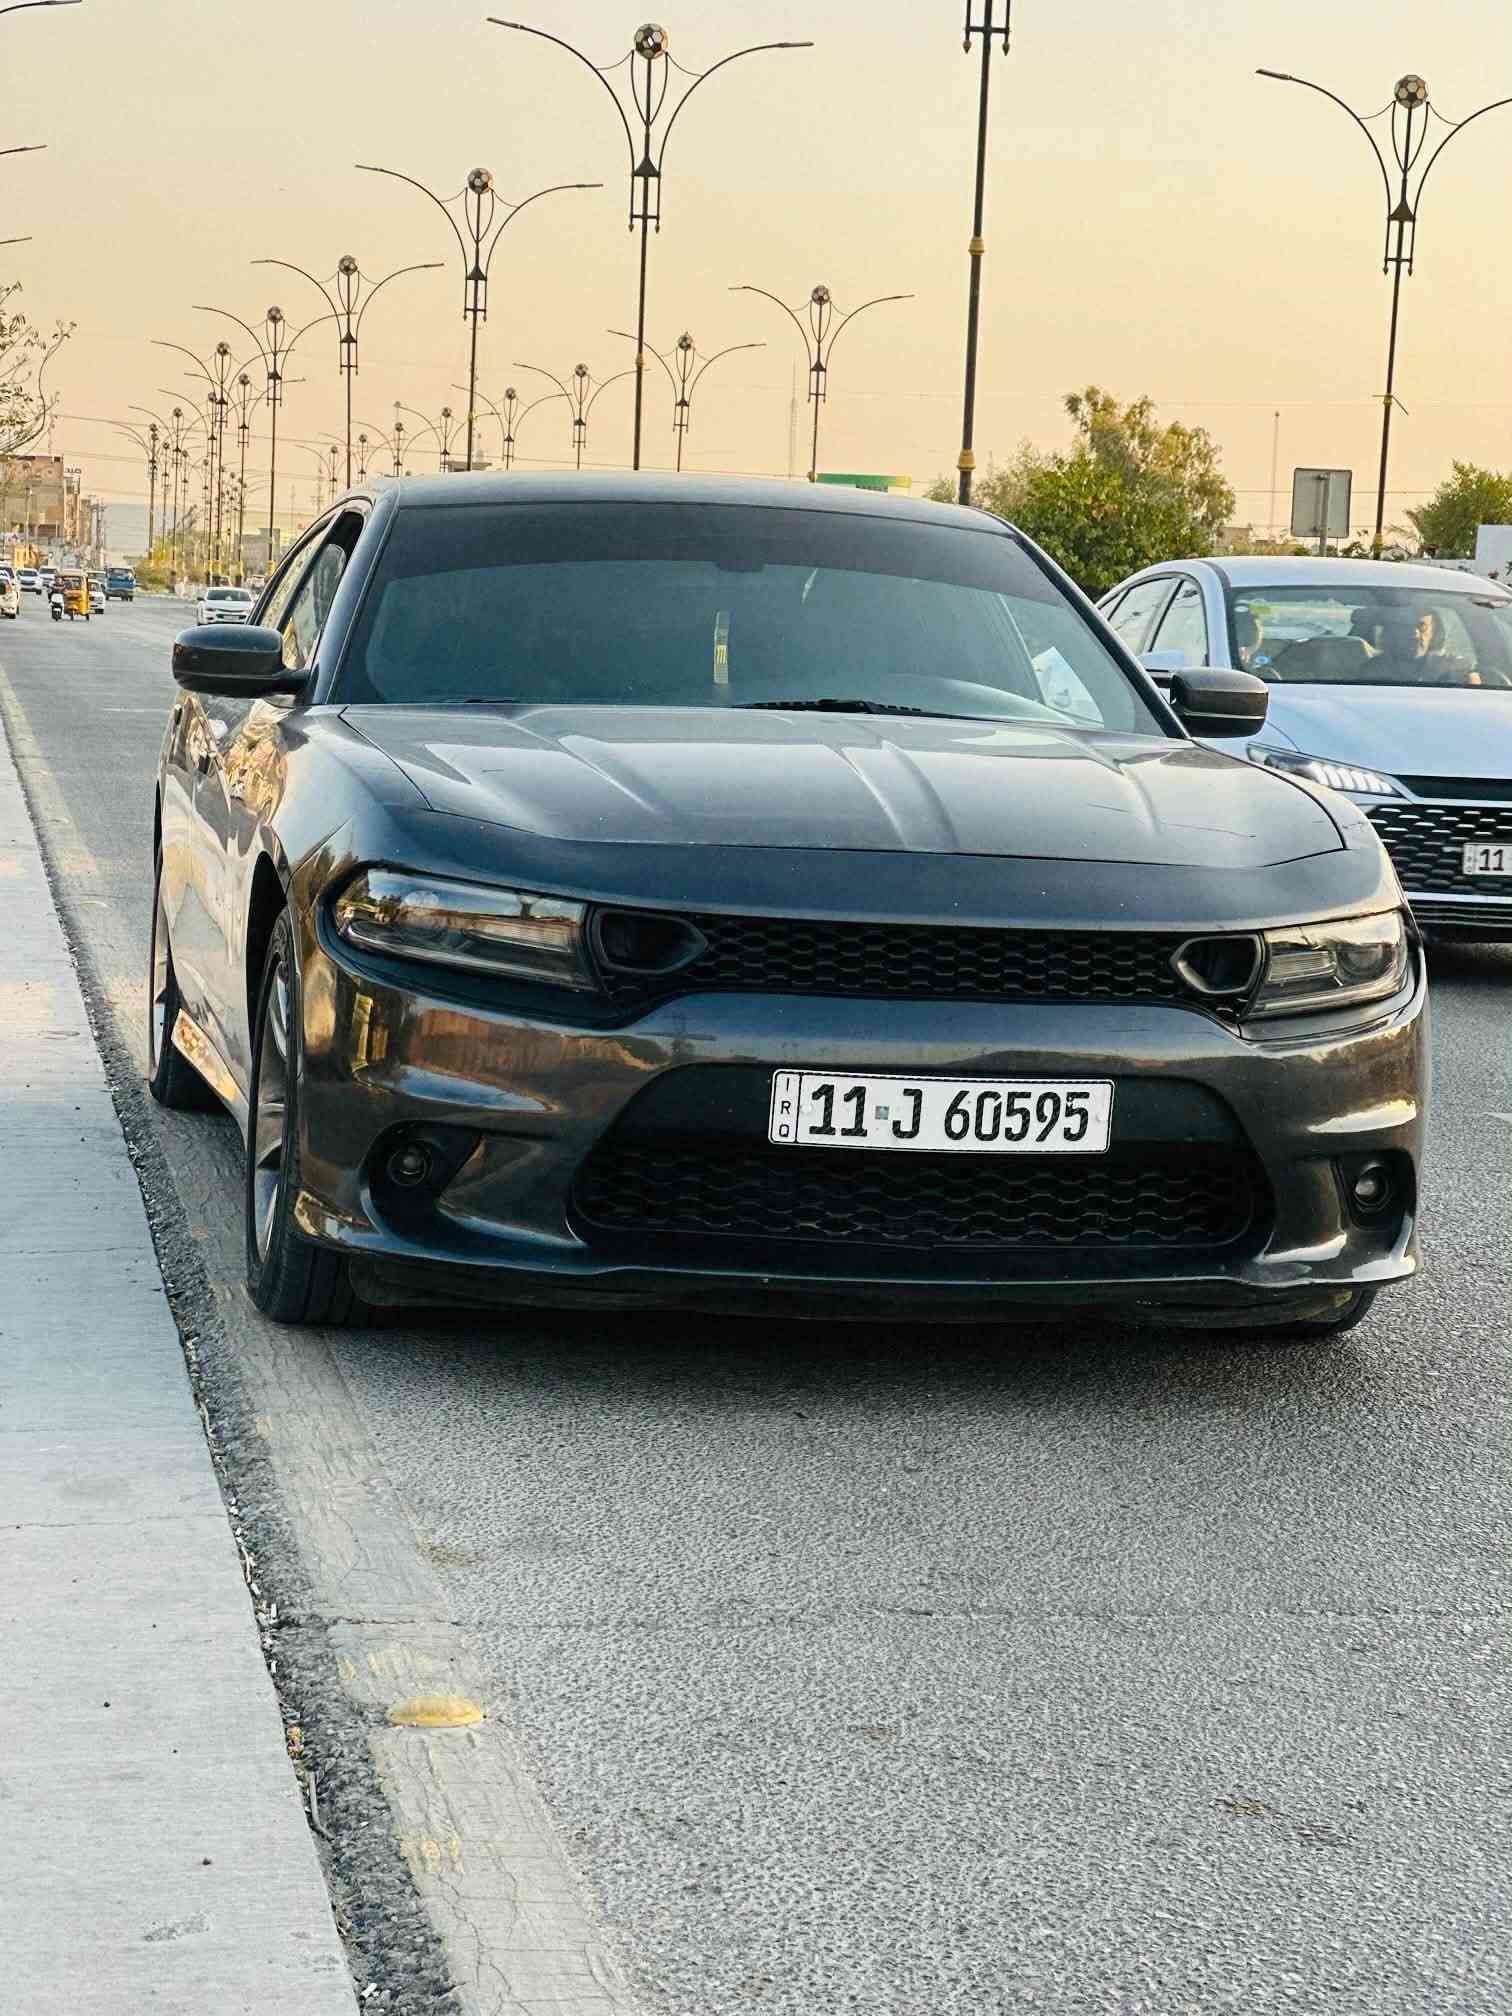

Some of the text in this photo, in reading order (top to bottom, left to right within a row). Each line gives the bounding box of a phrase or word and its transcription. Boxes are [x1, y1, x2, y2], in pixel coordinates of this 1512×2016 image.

[1479, 849, 1504, 872] 11
[778, 1078, 791, 1138] IRQ
[808, 1083, 1090, 1142] 11 J 60595
